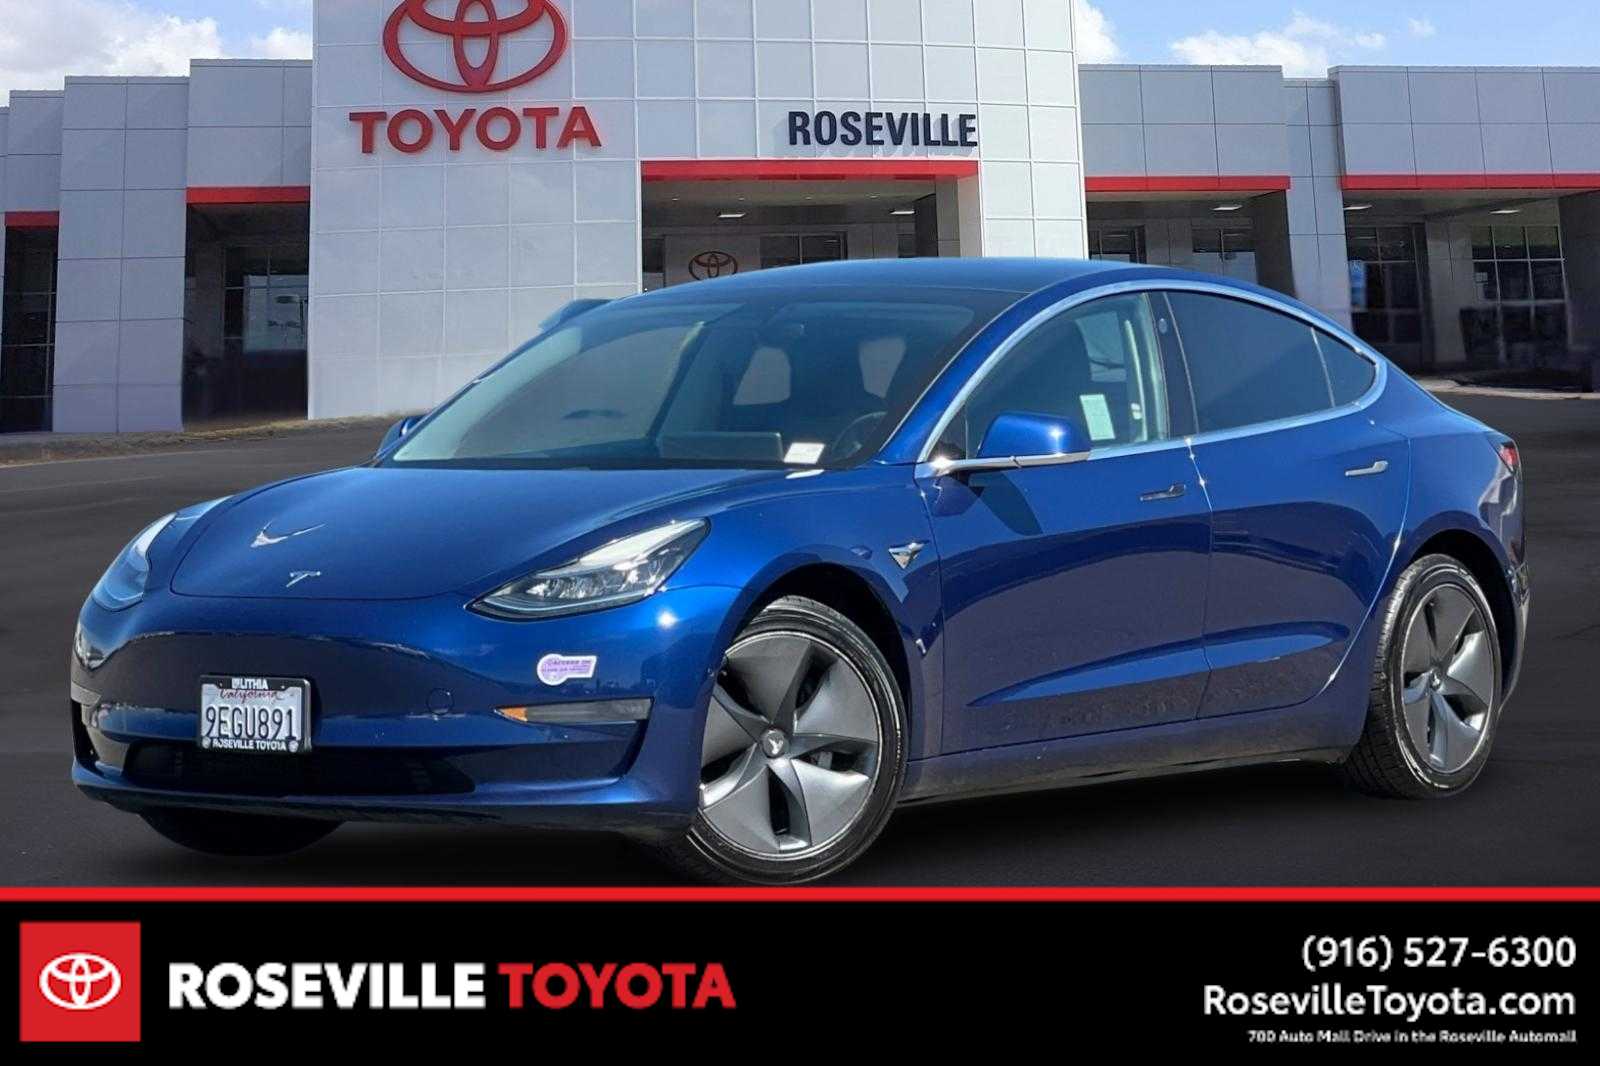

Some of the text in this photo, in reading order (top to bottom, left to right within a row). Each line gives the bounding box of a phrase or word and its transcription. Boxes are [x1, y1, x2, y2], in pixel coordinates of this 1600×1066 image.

[349, 106, 602, 154] TOYOTA
[788, 111, 978, 147] ROSEVILLE
[241, 678, 269, 690] LITHIA
[205, 706, 295, 740] 9EGU891
[212, 739, 287, 752] ROSEVILLE TOYOTA
